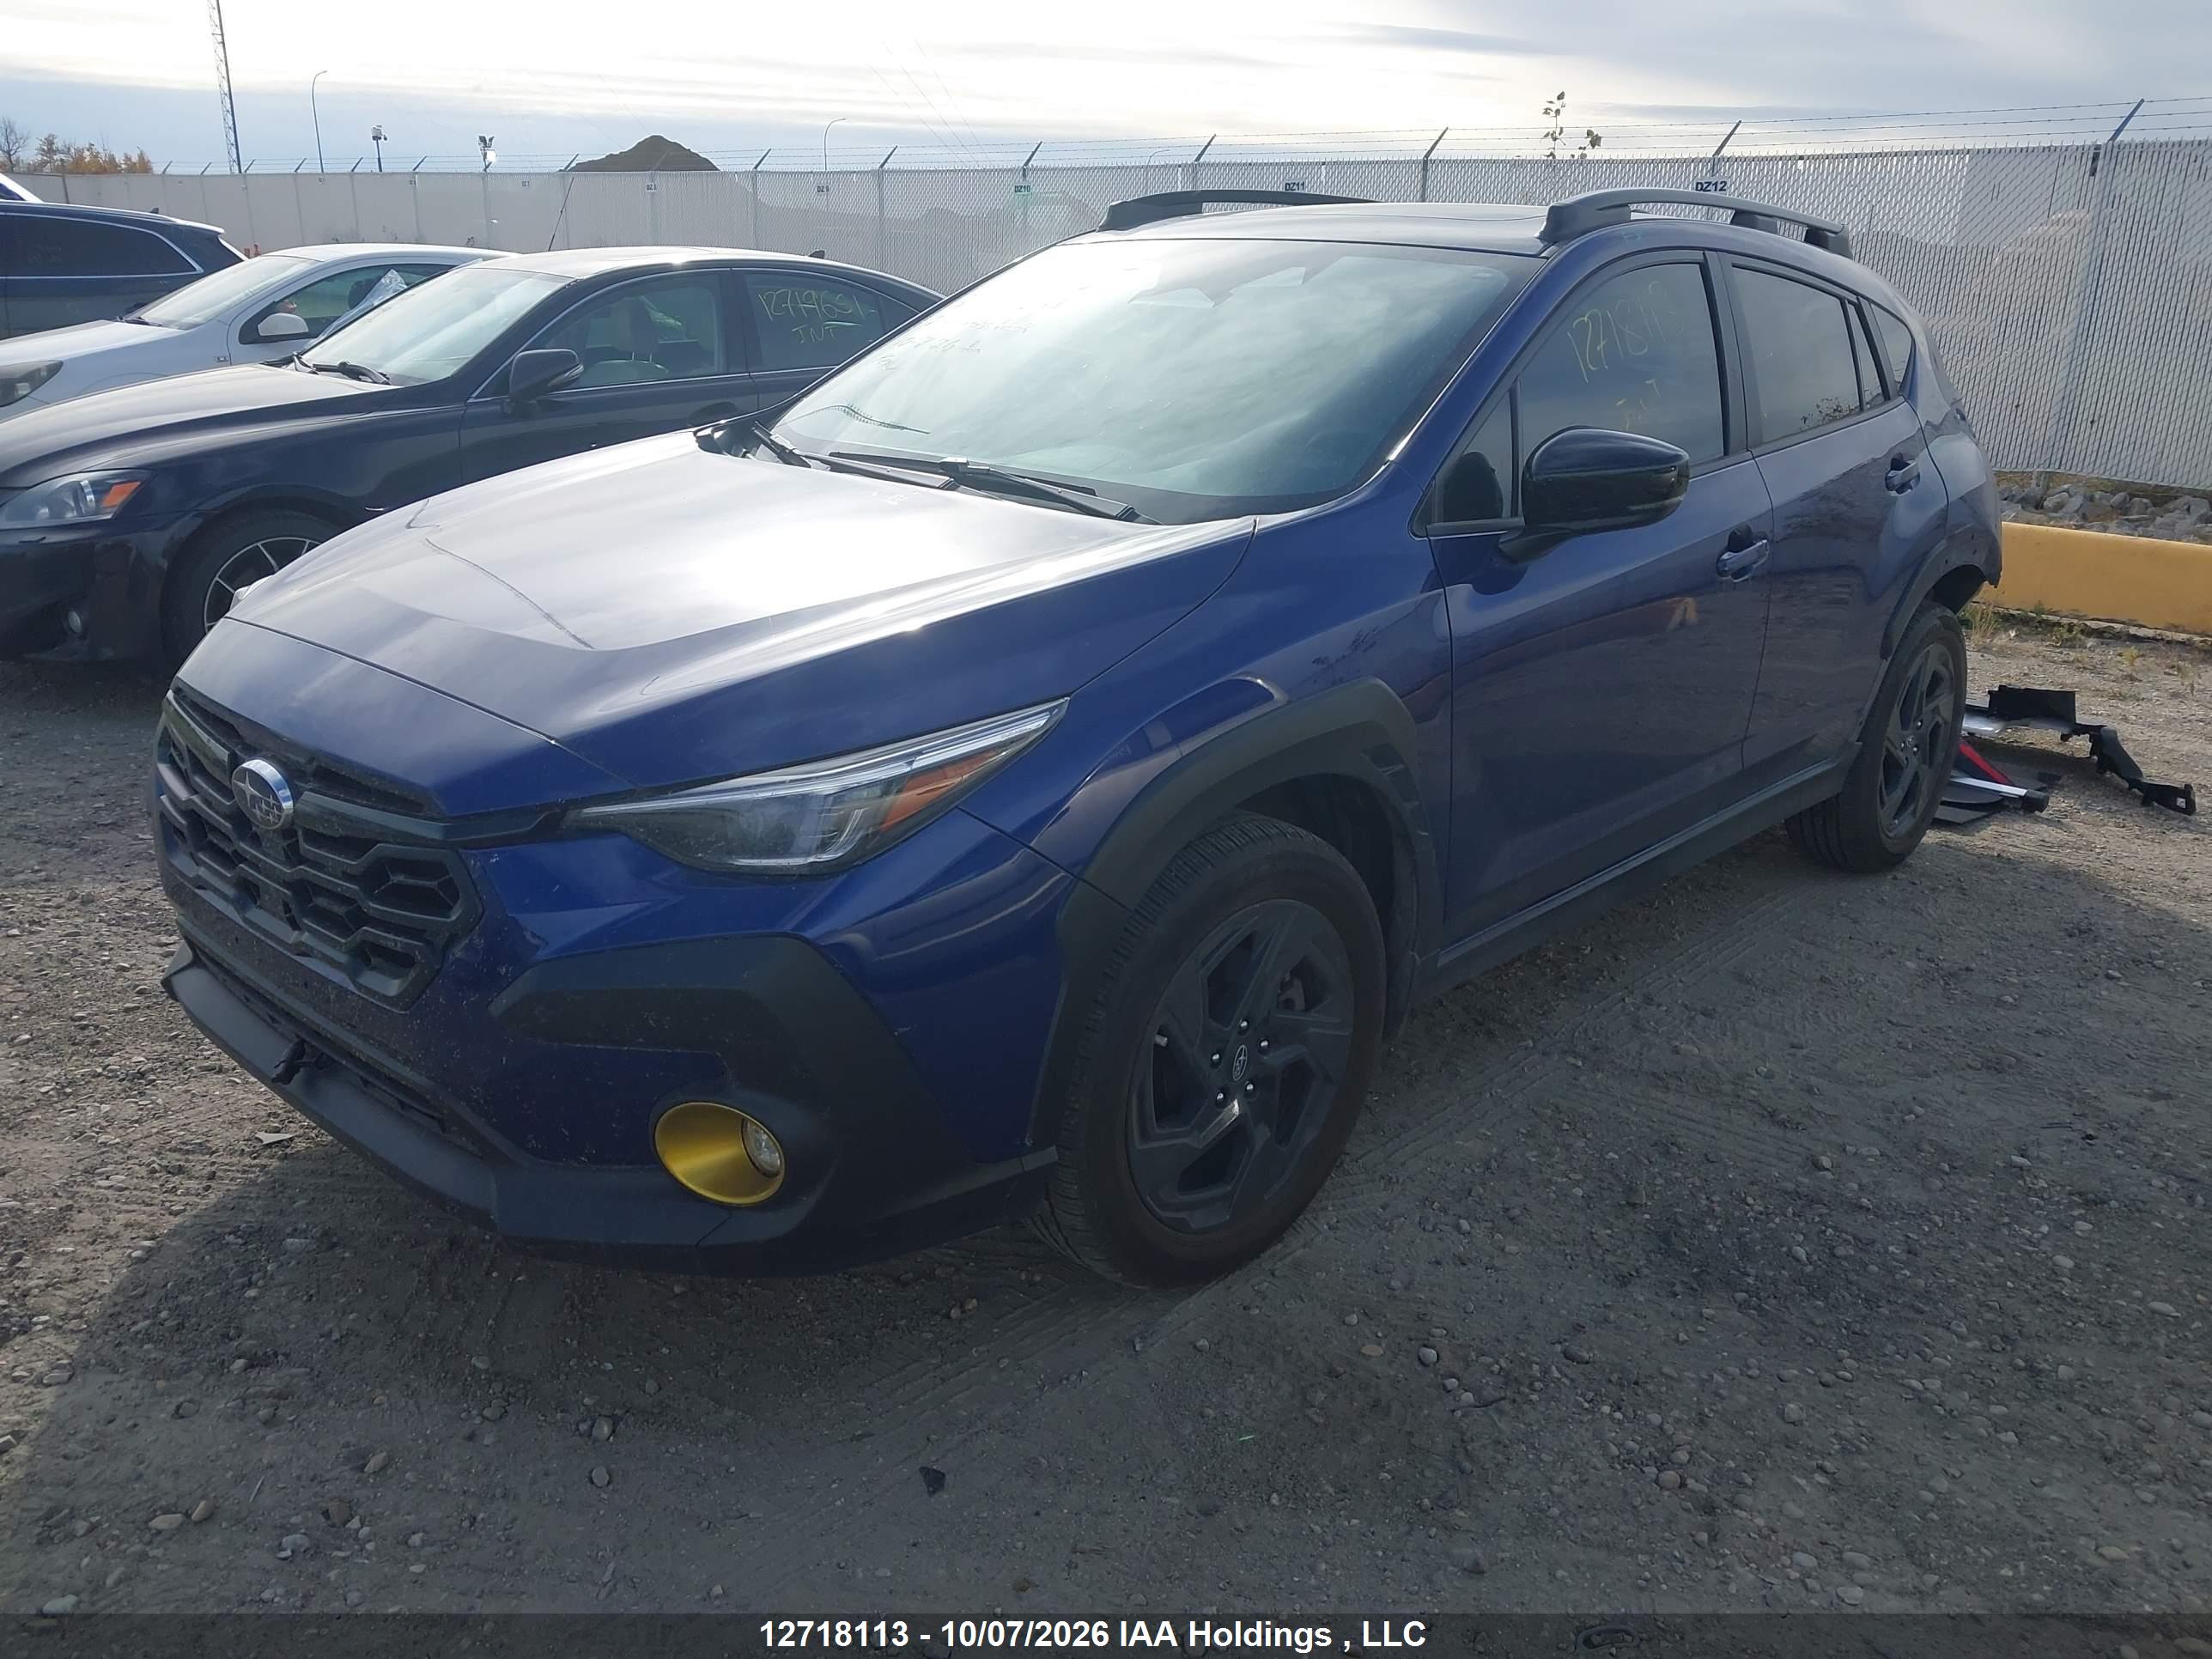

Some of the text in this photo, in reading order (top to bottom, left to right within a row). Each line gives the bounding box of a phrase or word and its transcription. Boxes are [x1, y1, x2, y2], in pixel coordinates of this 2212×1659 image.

[1014, 184, 1030, 193] DZ10
[1285, 181, 1305, 191] DZ11
[1695, 180, 1728, 192] DZ12
